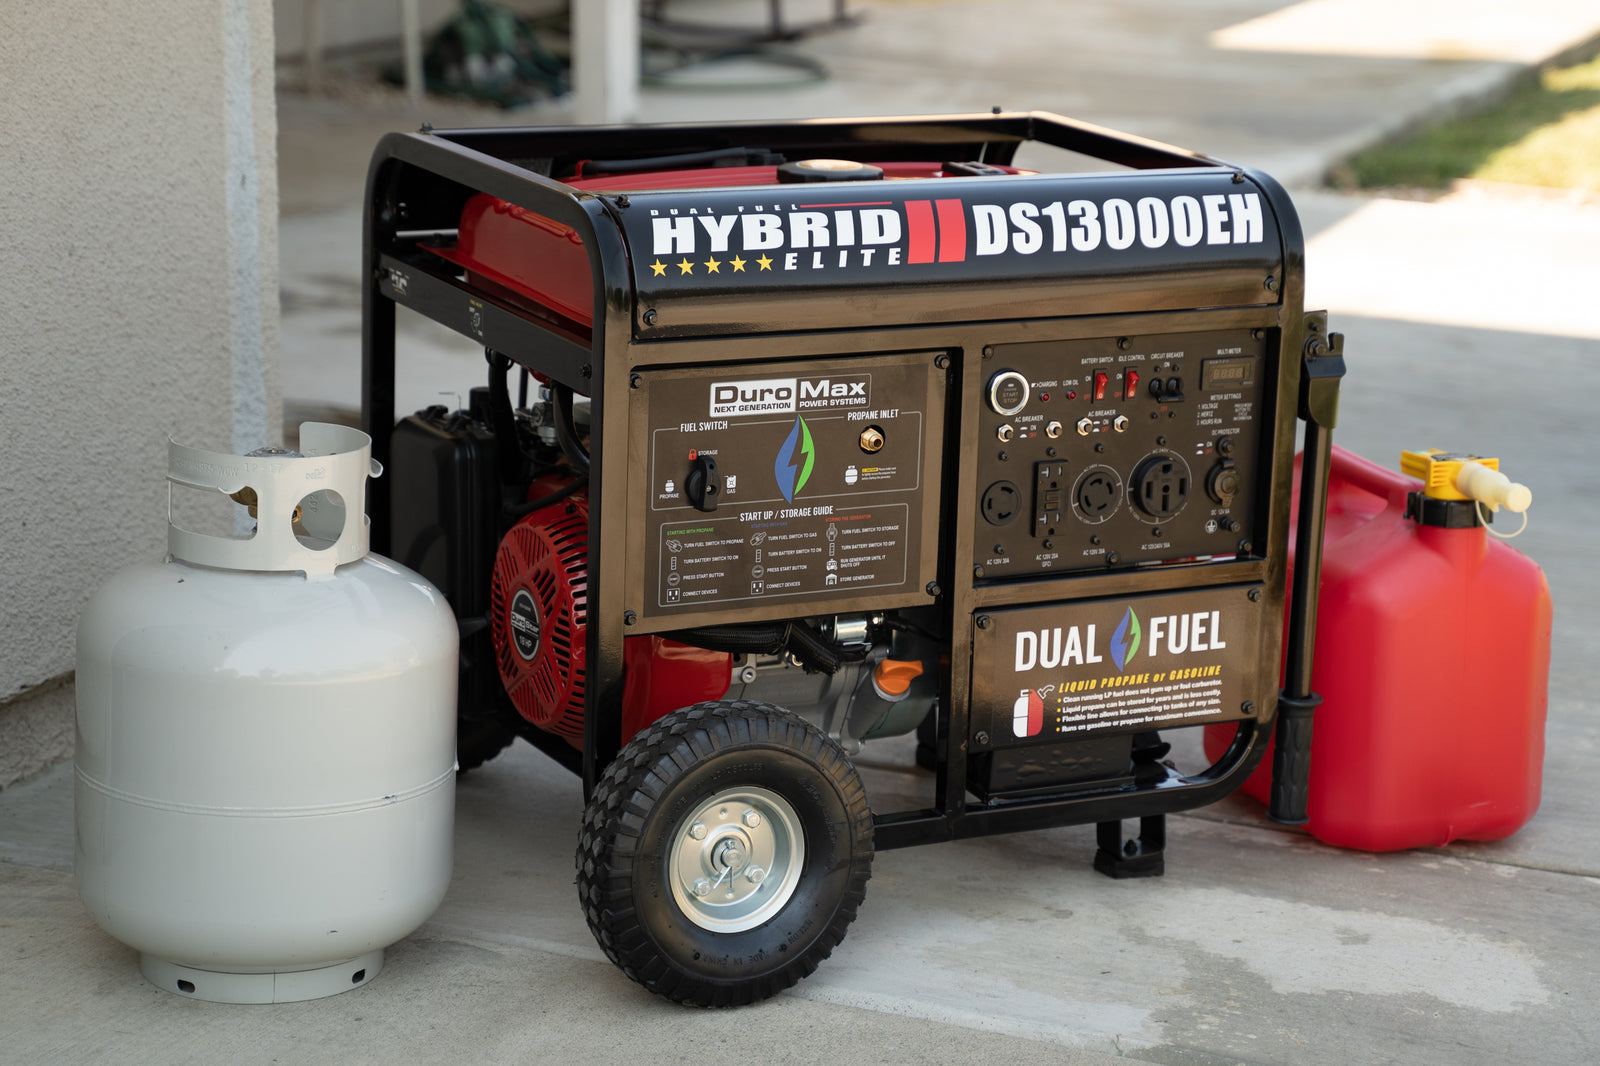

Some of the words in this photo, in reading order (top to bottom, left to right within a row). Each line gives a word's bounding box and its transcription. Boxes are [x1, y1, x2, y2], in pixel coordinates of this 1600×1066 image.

[651, 207, 714, 216] DUAL
[738, 204, 798, 212] FUEL
[652, 208, 901, 254] HYBRID
[972, 193, 1263, 256] DS13000EH
[785, 248, 900, 270] ELITE
[1127, 354, 1145, 362] CONTROL
[1038, 380, 1058, 388] CHARGING
[714, 405, 737, 413] NEXT
[738, 402, 791, 412] GENERATION
[800, 399, 828, 408] POWER
[830, 397, 866, 406] SYSTEMS
[1095, 409, 1116, 417] BREAKER
[847, 410, 879, 421] PROPANE
[880, 409, 899, 418] INLET
[1022, 415, 1044, 423] BREAKER
[680, 423, 698, 433] FUEL
[699, 421, 728, 431] SWITCH
[740, 510, 762, 521] START
[764, 509, 773, 519] UP
[774, 510, 778, 519] /
[780, 507, 812, 518] STORAGE
[813, 506, 834, 516] GUIDE
[1015, 624, 1103, 672] DUAL
[1149, 610, 1226, 657] FUEL
[1059, 680, 1097, 693] LIQUID
[1101, 673, 1150, 688] PROPANE
[1153, 673, 1165, 682] or
[1169, 665, 1221, 680] GASOLINE
[1063, 695, 1080, 703] Clean
[1081, 692, 1104, 703] running
[1104, 691, 1112, 699] LP
[1113, 690, 1124, 698] fuel
[1125, 688, 1139, 696] does
[1140, 687, 1150, 695] not
[1150, 686, 1163, 695] gum
[1164, 685, 1172, 693] up
[1191, 679, 1222, 689] carburetor.
[1062, 705, 1080, 715] Liquid
[1081, 702, 1106, 713] propane
[1127, 698, 1145, 706] stored
[1155, 695, 1171, 704] years
[1172, 693, 1183, 701] and
[1190, 691, 1202, 699] less
[1062, 713, 1086, 722] Flexible
[1099, 710, 1118, 718] allows
[1129, 705, 1162, 716] connecting
[1171, 702, 1187, 710] tanks
[1196, 700, 1207, 708] any
[1062, 724, 1077, 732] Runs
[1086, 720, 1112, 731] gasoline
[1120, 717, 1144, 727] propane
[1154, 713, 1183, 721] maximum
